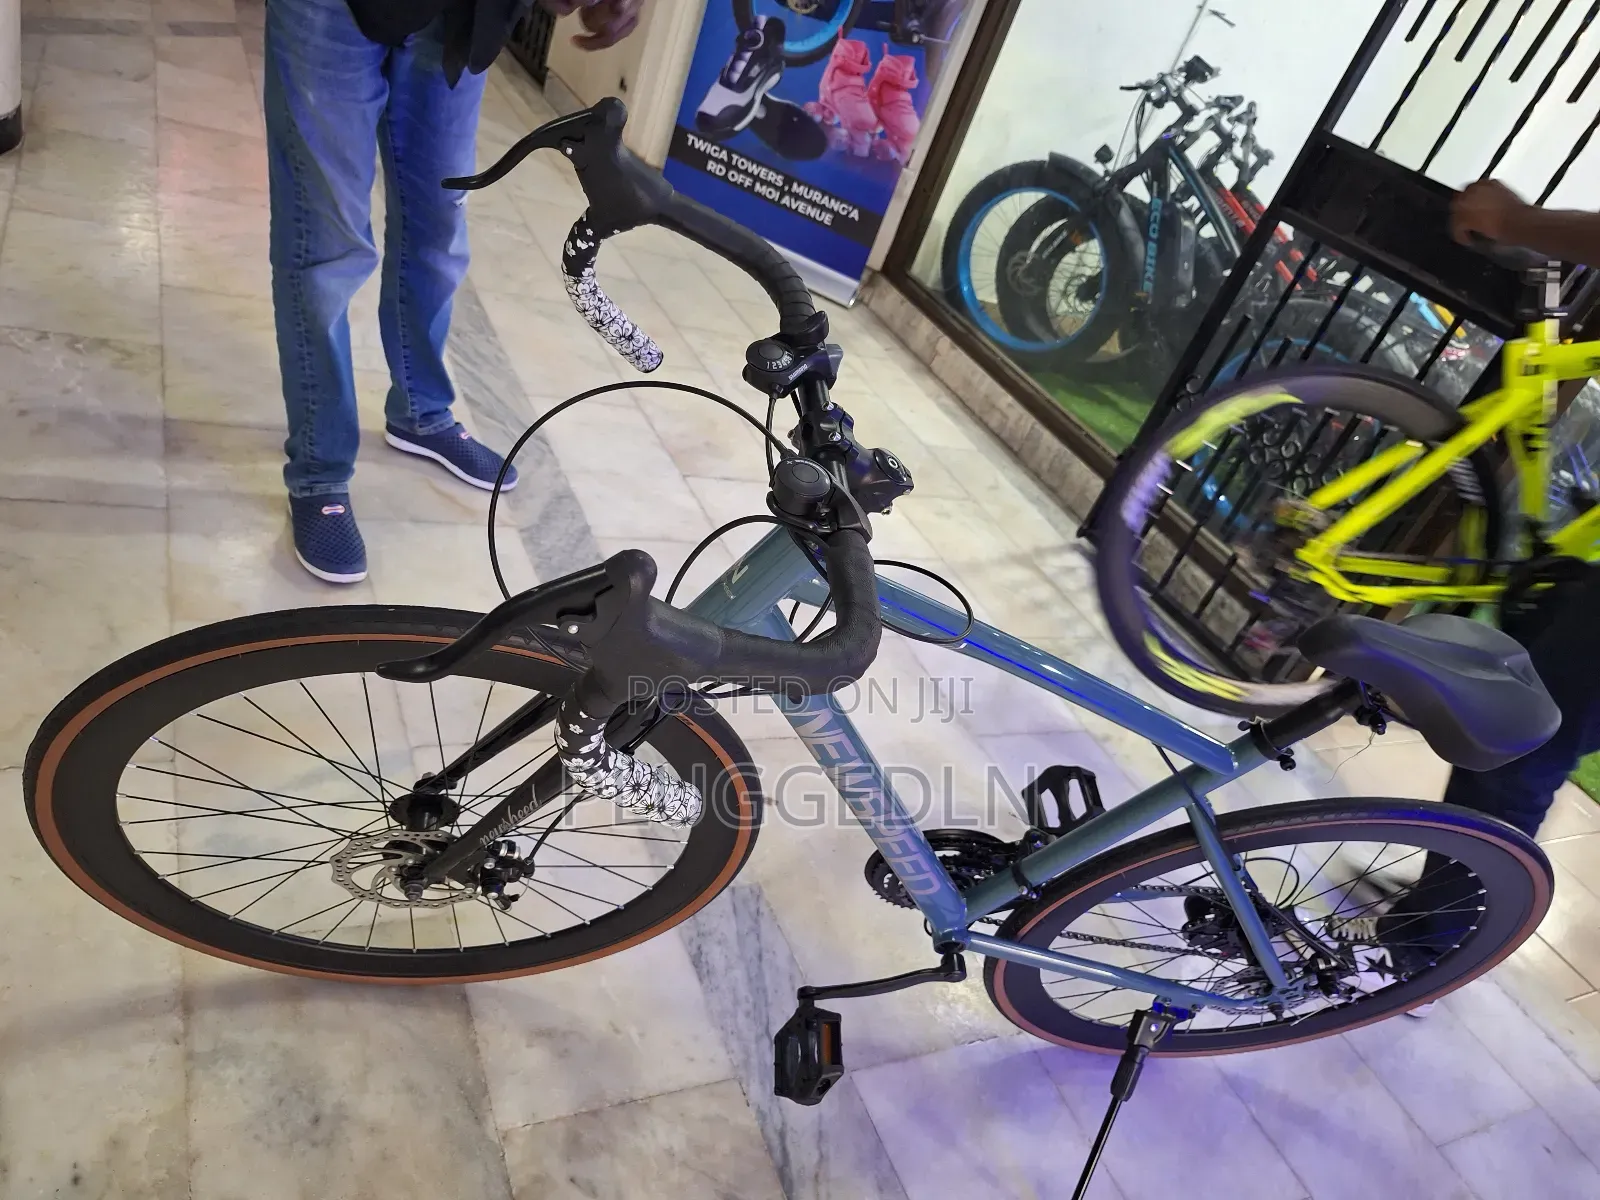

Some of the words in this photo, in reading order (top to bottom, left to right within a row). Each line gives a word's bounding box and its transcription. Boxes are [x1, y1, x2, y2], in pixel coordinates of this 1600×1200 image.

[687, 133, 729, 163] TWIGA
[731, 153, 784, 187] TOWERS
[791, 181, 860, 222] MURANG'A
[706, 160, 727, 177] RD
[727, 170, 753, 189] OFF
[754, 181, 781, 203] MOI
[780, 194, 835, 226] AVENUE
